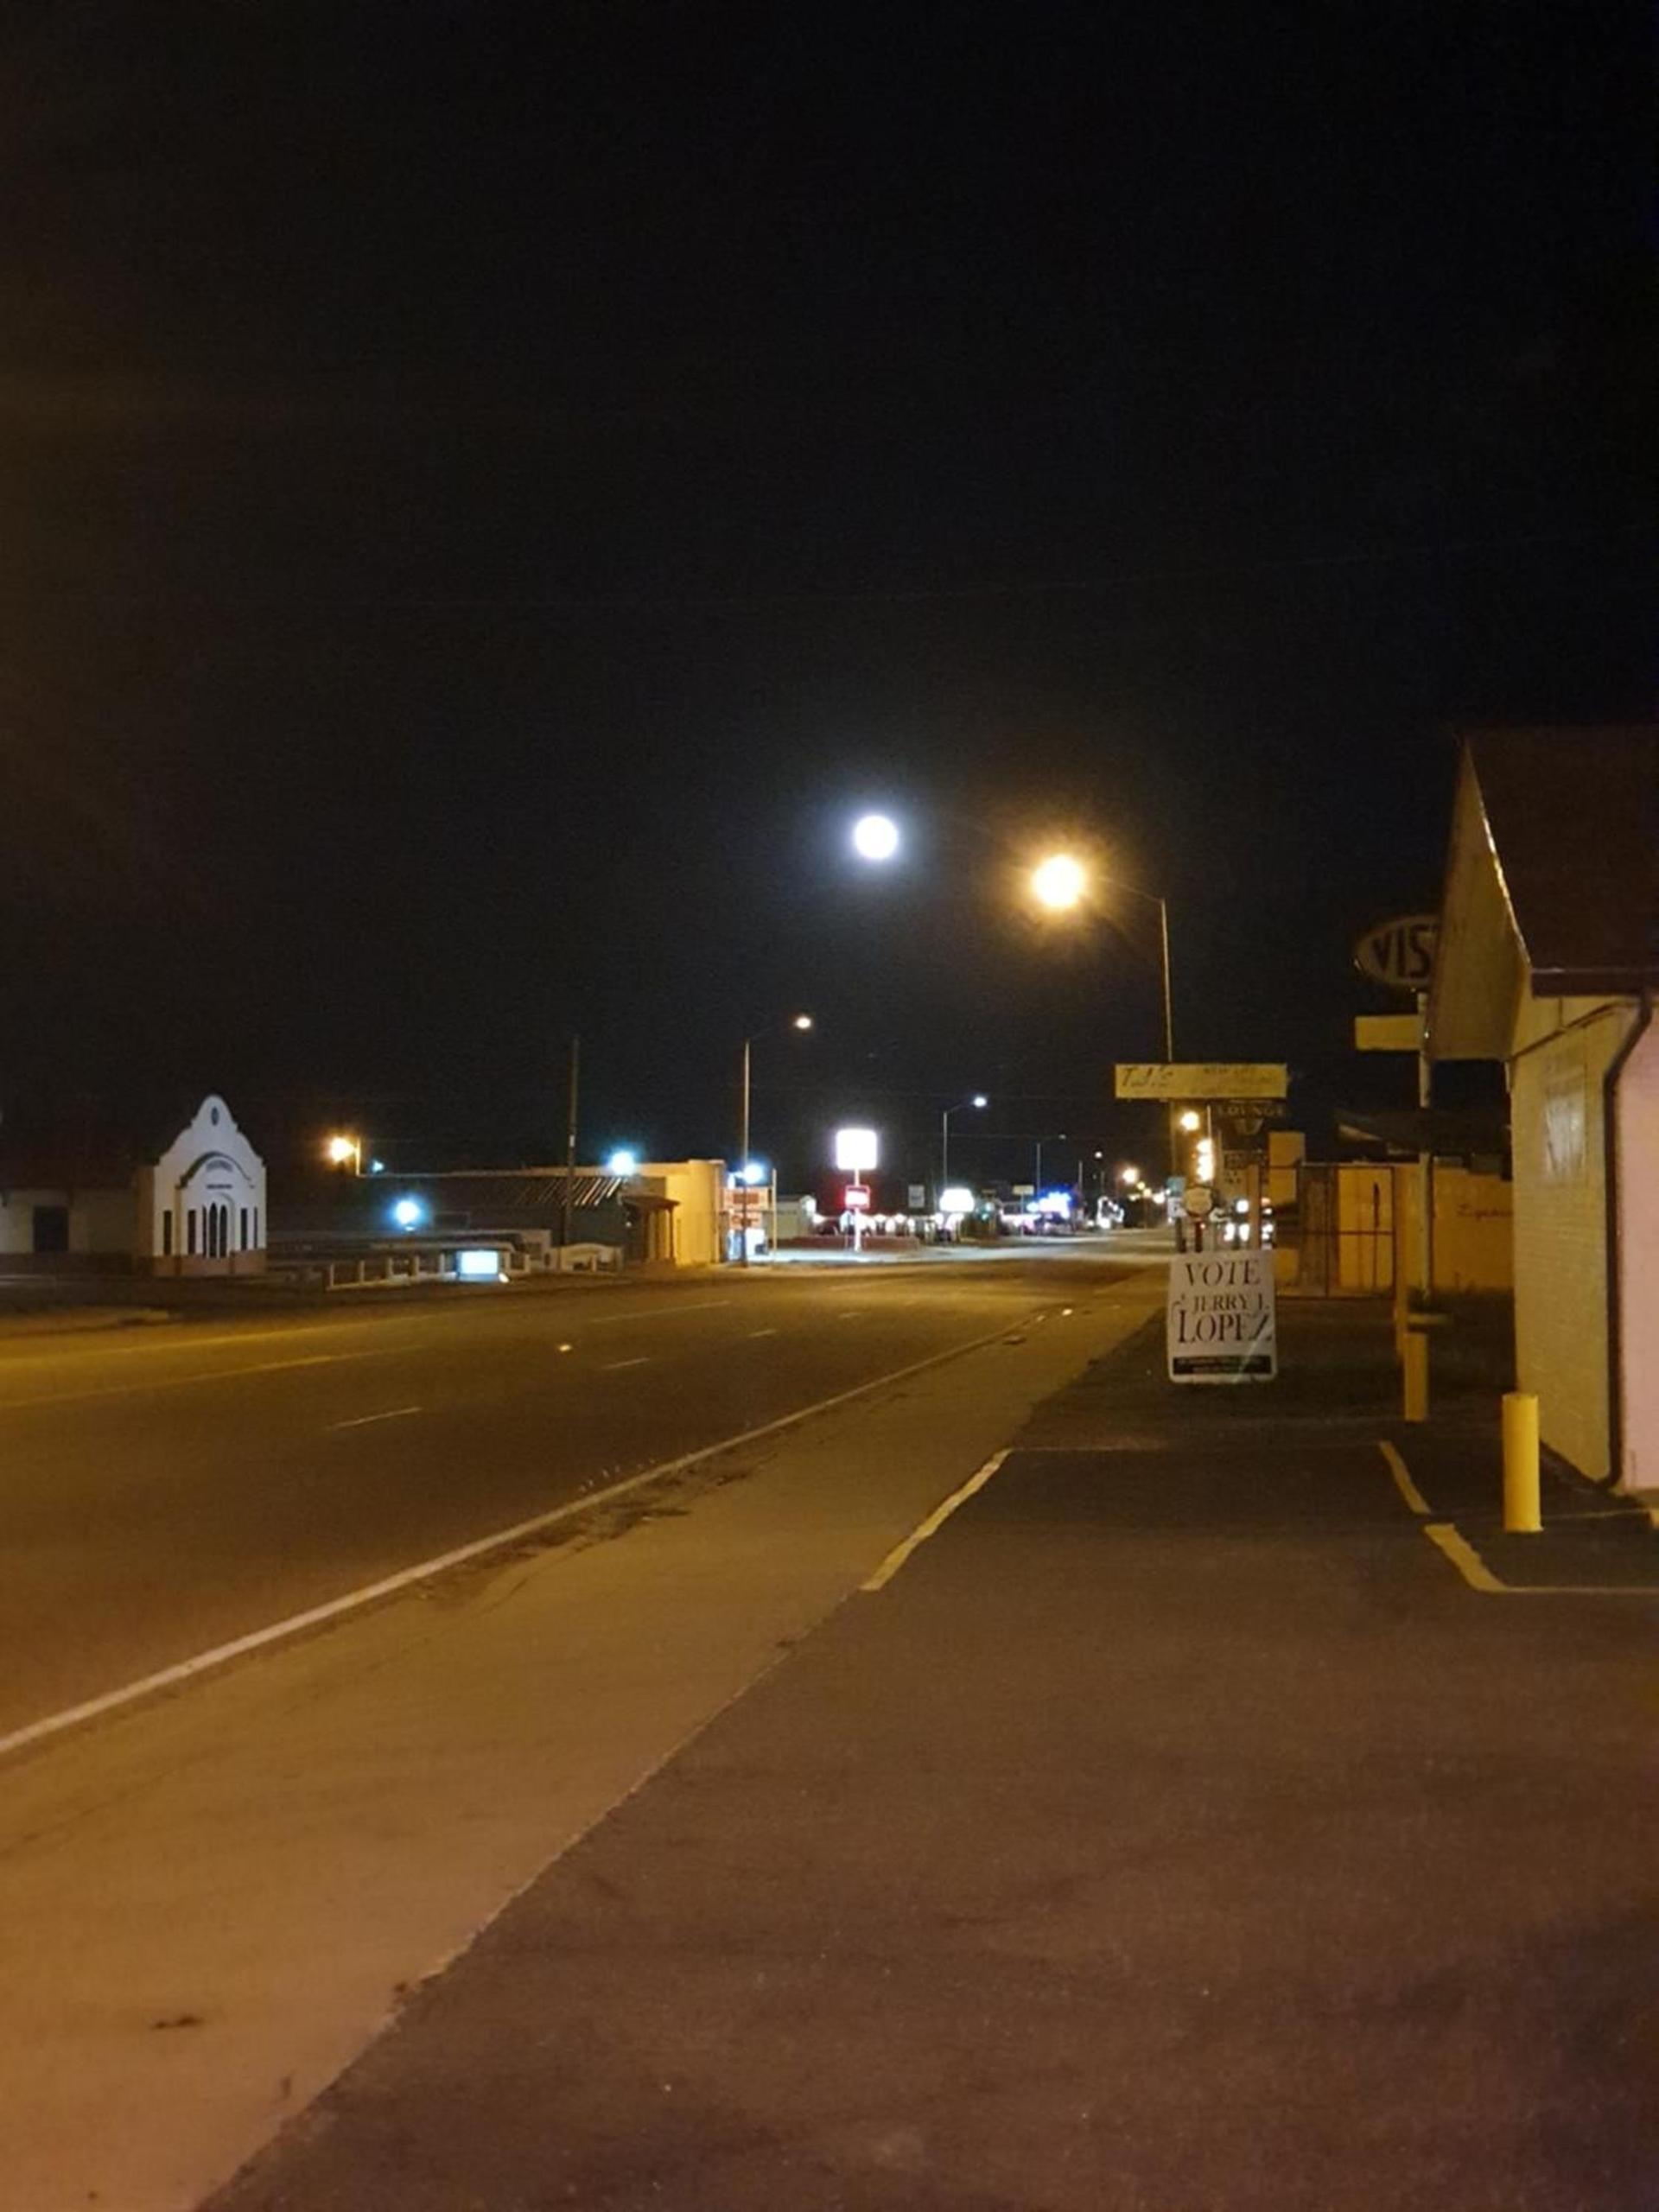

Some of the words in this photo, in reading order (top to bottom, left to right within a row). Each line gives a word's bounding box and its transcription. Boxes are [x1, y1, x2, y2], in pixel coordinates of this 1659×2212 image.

[1371, 923, 1436, 974] VIS
[1185, 1260, 1261, 1285] VOTE
[1191, 1293, 1249, 1314] JERRY
[1179, 1309, 1272, 1343] LOPEZ
